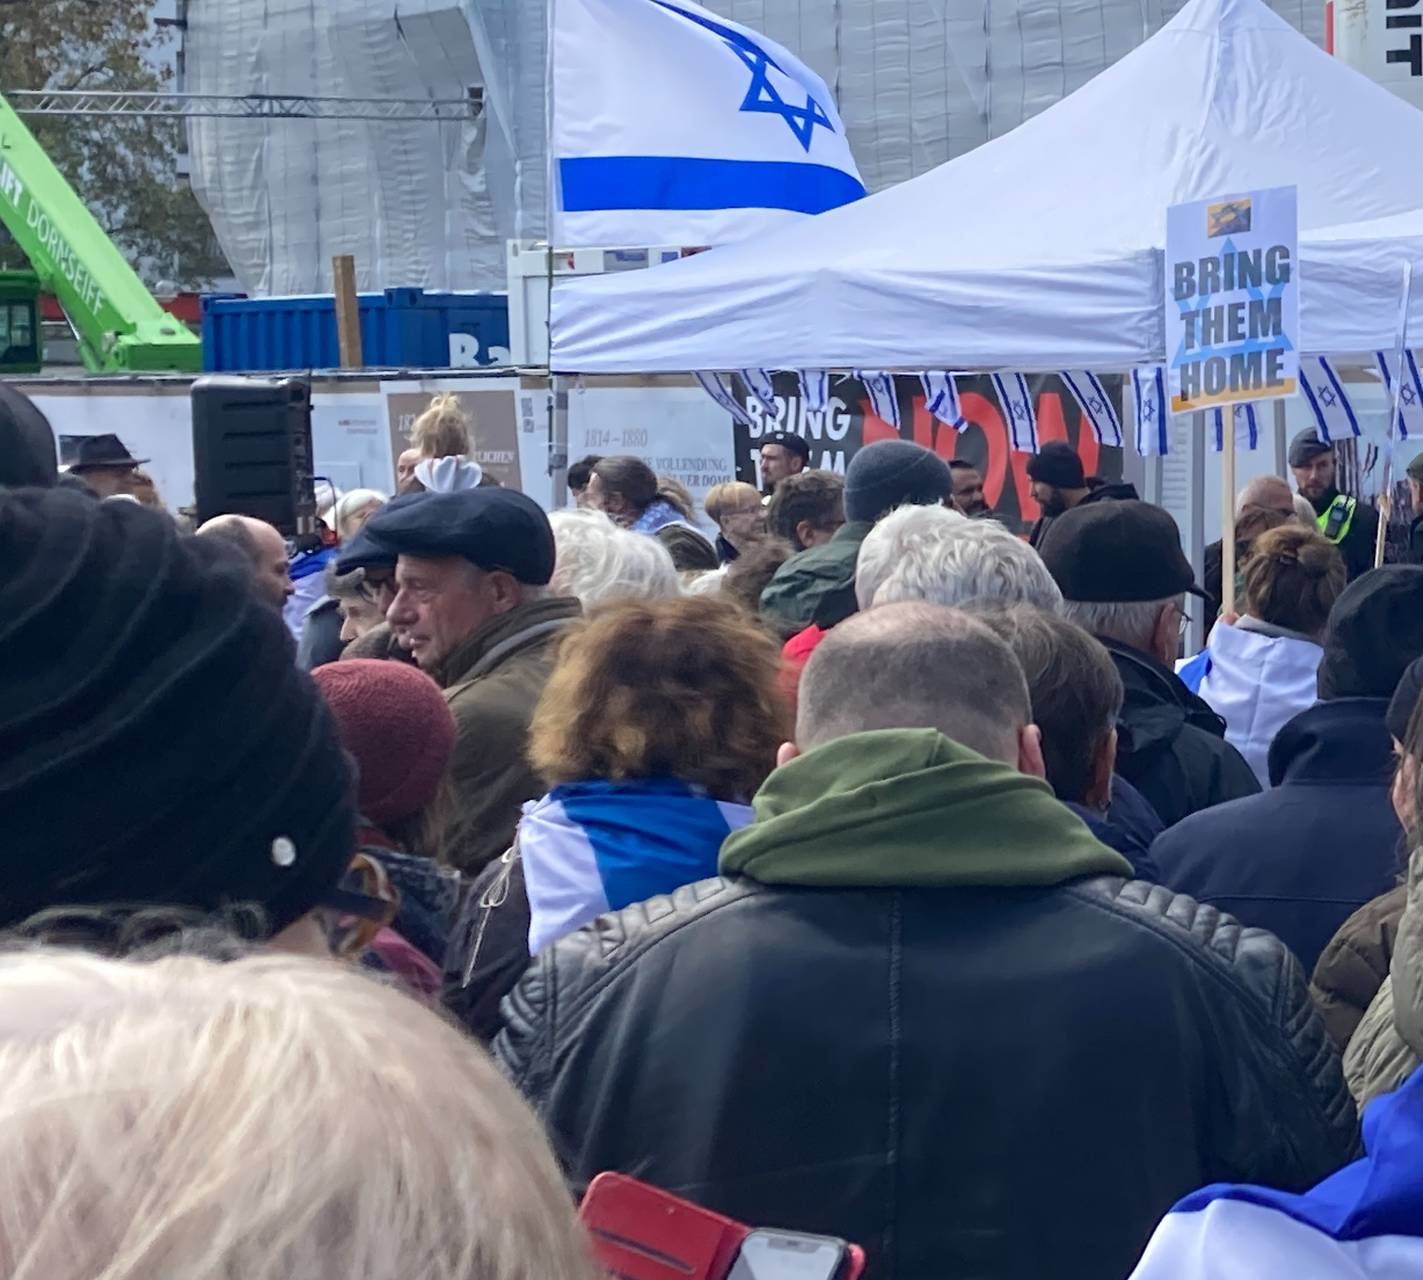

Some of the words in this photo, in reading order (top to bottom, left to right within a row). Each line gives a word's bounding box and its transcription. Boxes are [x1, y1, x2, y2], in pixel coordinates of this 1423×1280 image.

[1386, 0, 1422, 76] IT
[26, 199, 104, 316] DORNSEIFF
[1173, 244, 1291, 302] BRING
[1180, 296, 1282, 350] THEM
[1180, 347, 1285, 402] HOME
[745, 395, 852, 440] BRING
